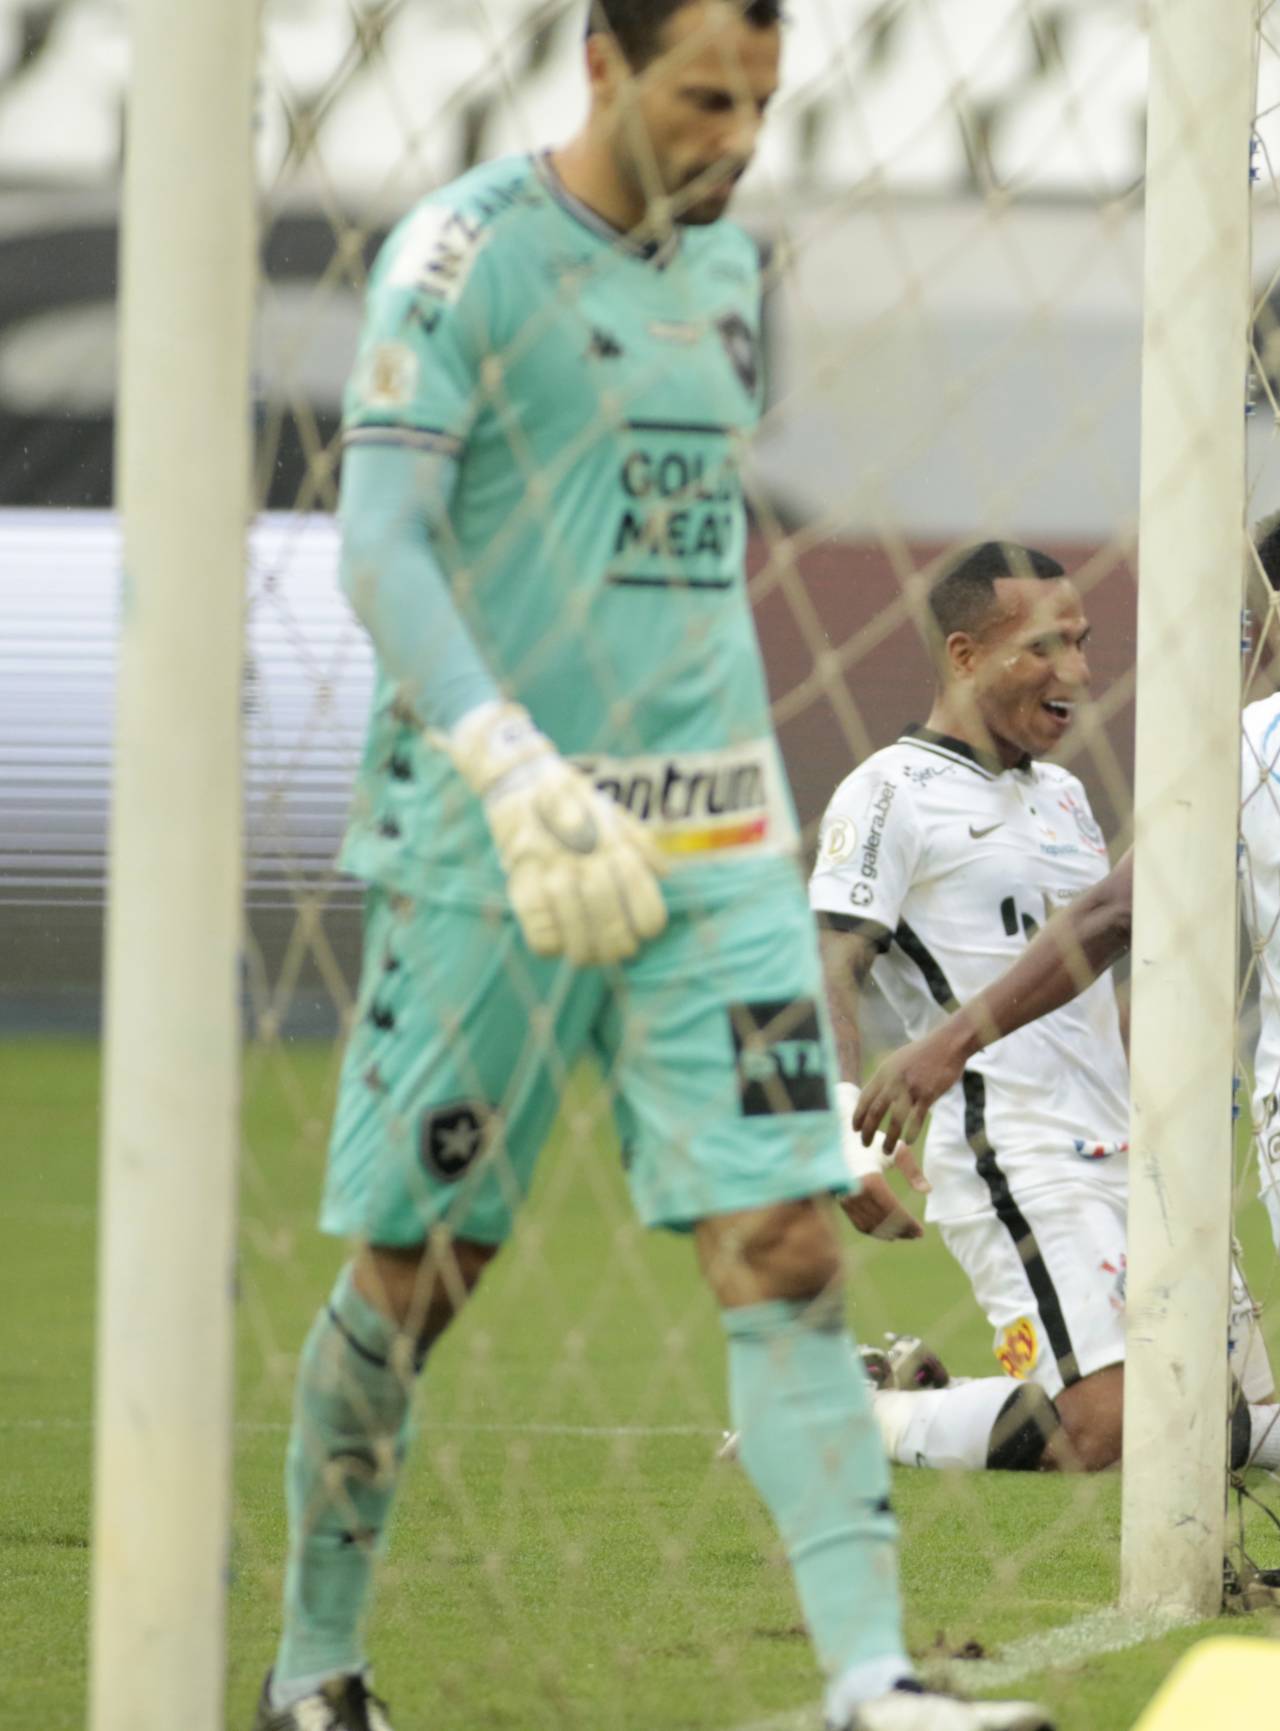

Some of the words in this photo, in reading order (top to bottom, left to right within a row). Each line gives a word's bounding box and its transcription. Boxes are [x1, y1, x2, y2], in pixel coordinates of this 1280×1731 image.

[613, 510, 733, 558] MEA
[576, 760, 767, 821] entrum
[860, 780, 898, 880] galera.bet
